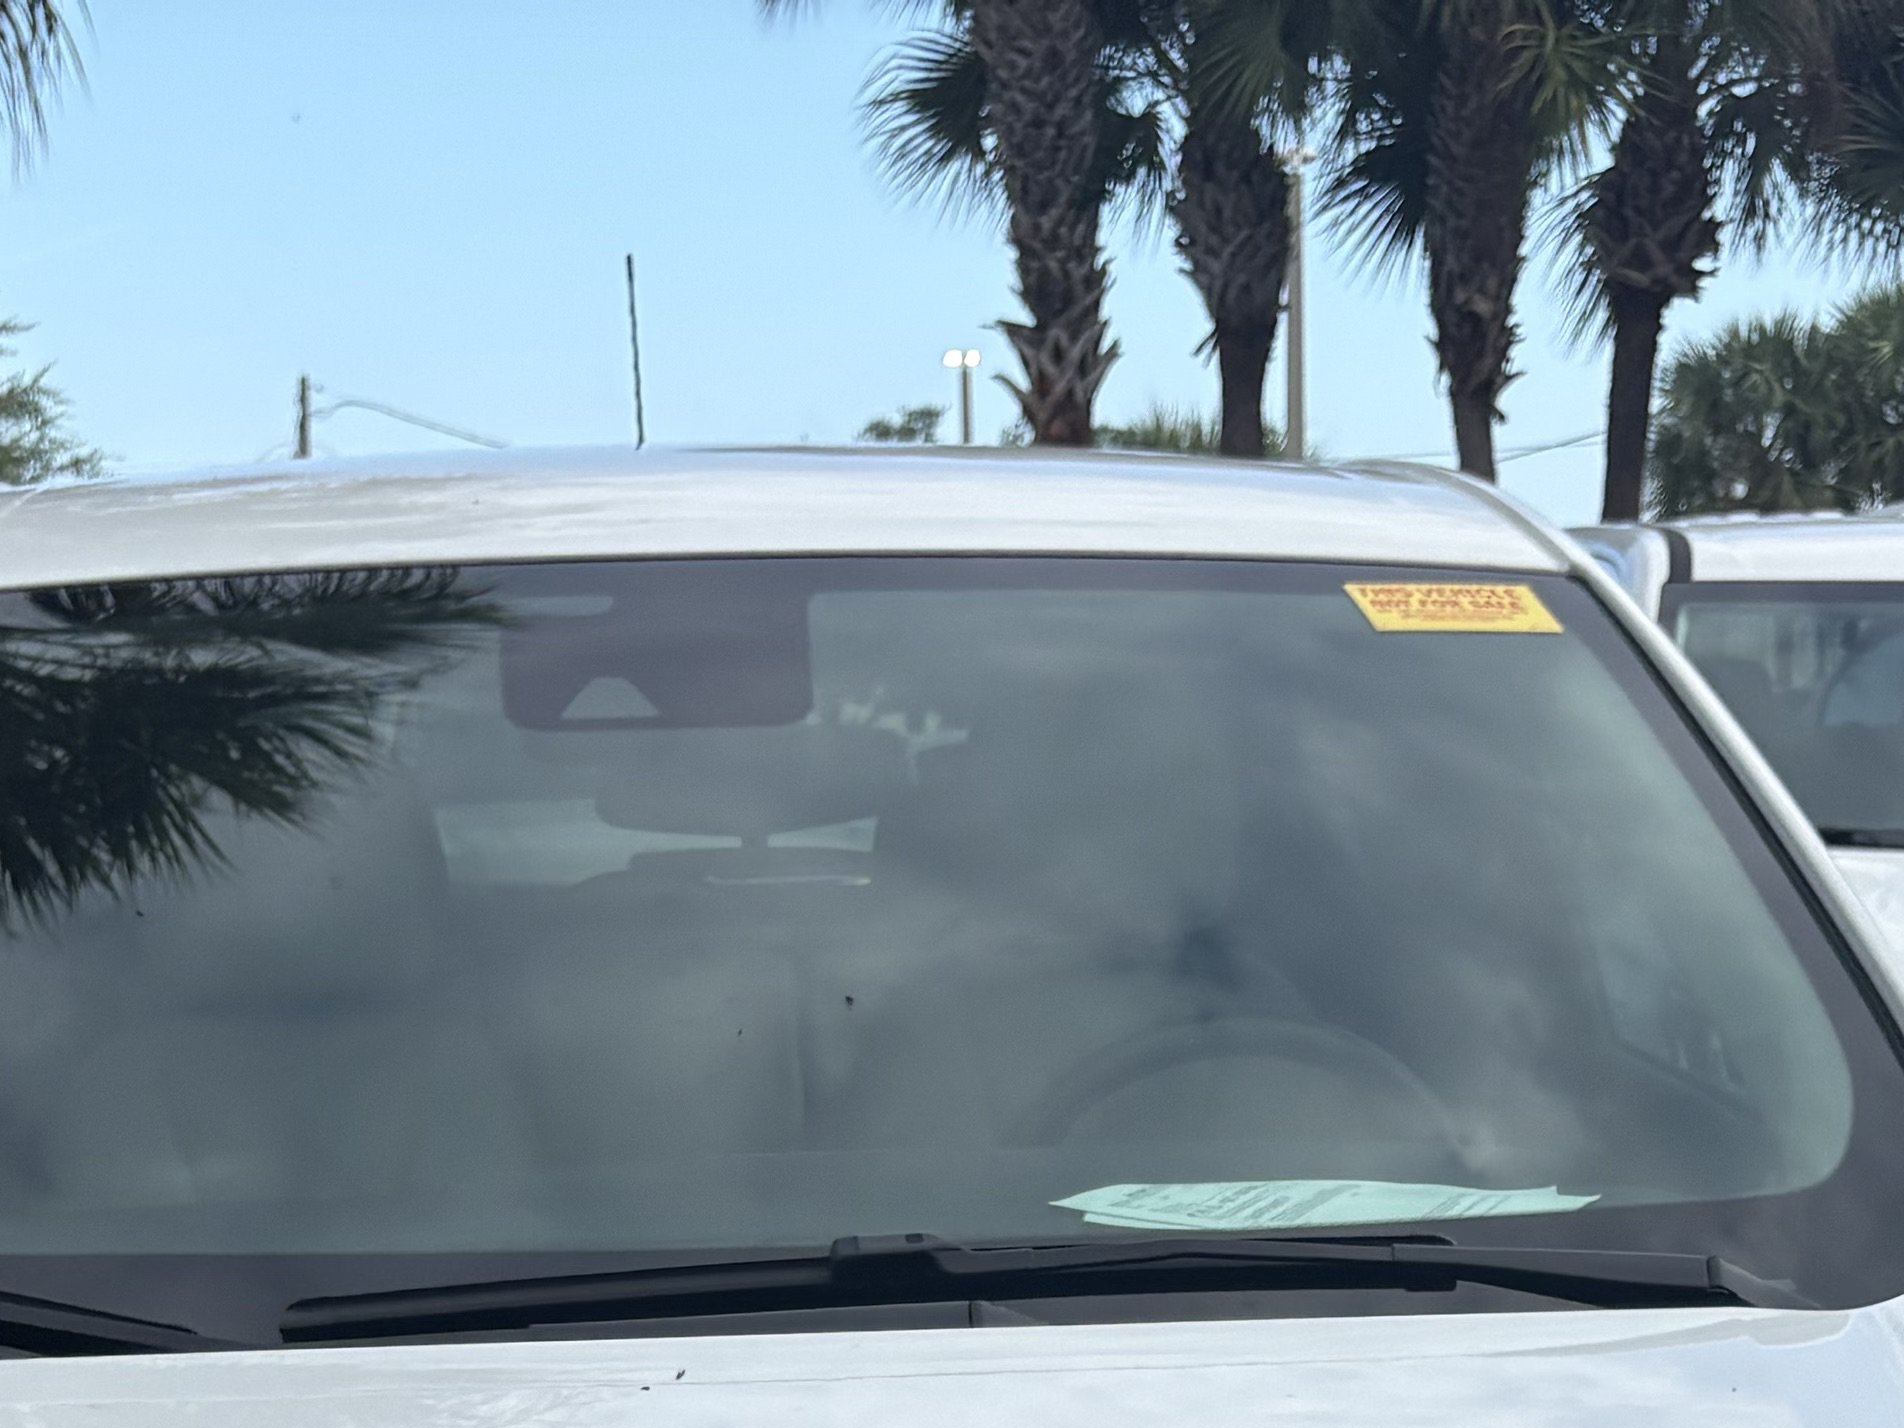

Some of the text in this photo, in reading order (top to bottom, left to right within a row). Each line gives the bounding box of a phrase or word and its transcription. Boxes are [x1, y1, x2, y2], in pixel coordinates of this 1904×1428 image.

[1416, 588, 1522, 600] VEHICLE
[1418, 599, 1461, 610] FOR
[1467, 601, 1523, 612] SALE
